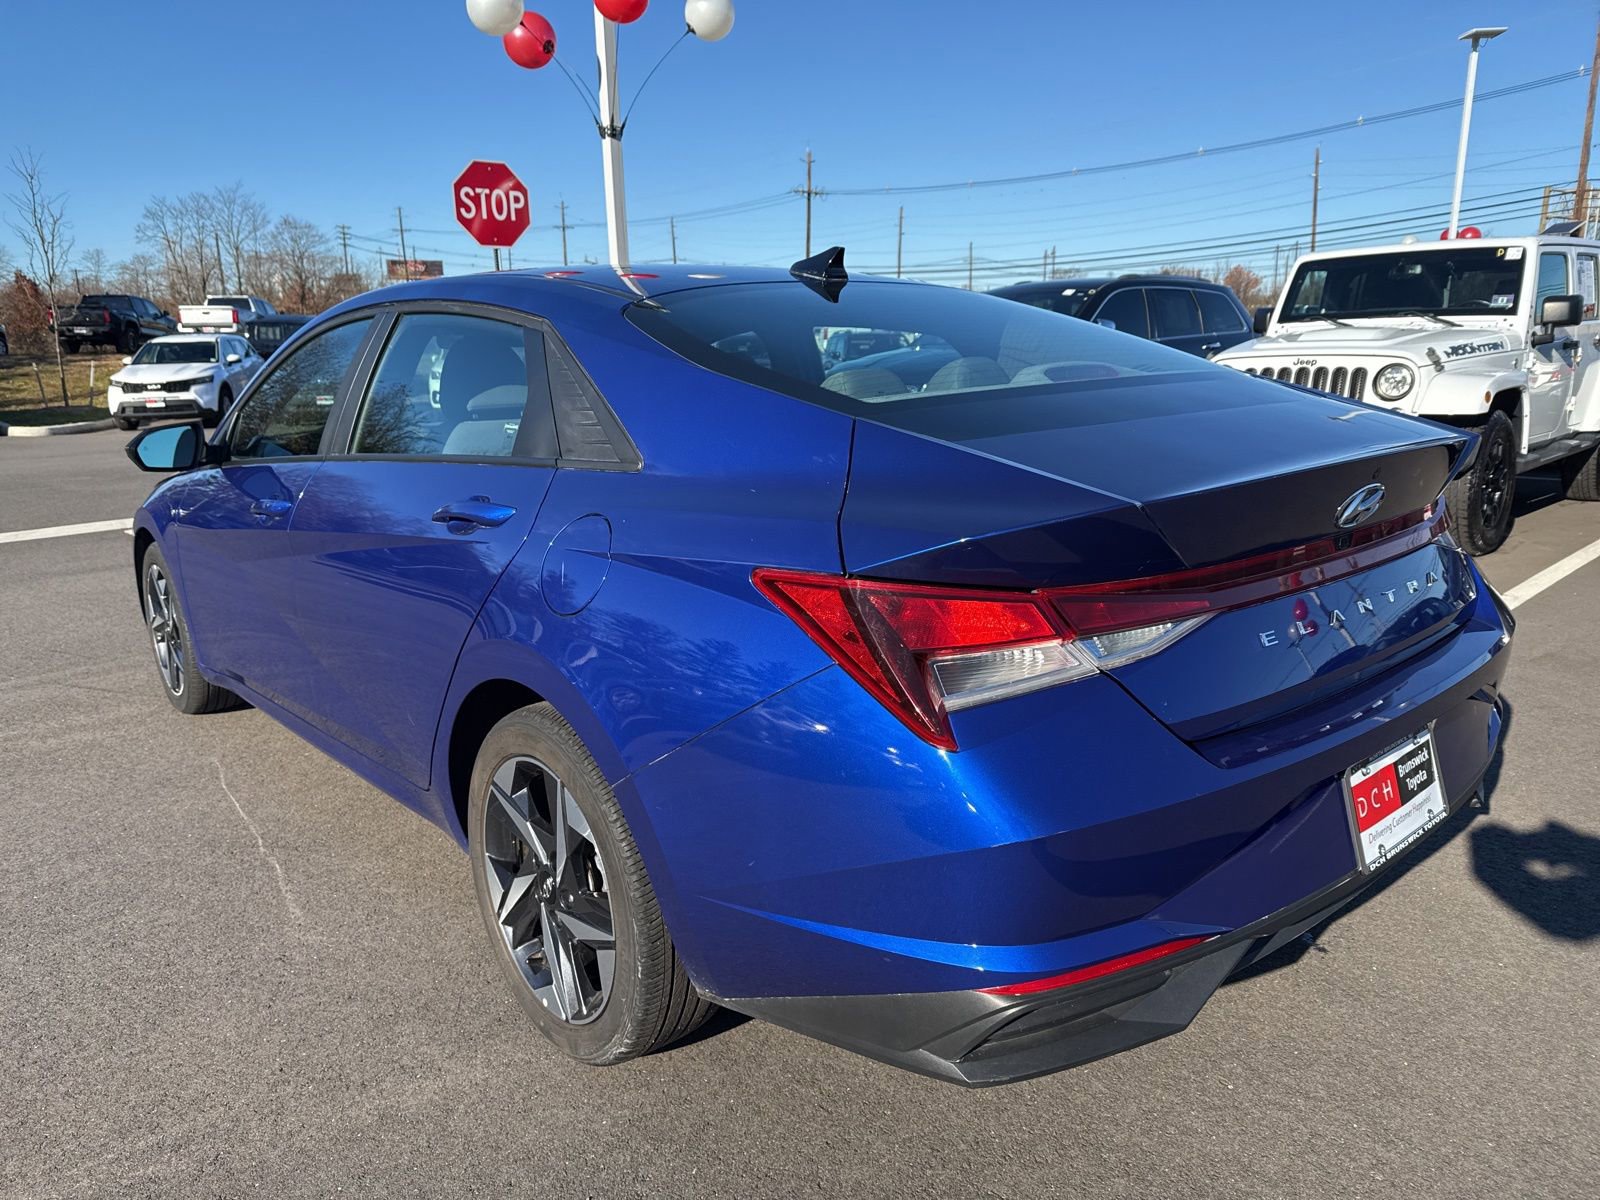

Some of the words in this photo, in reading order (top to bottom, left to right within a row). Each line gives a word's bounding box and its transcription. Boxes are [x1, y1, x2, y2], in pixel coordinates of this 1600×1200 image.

[460, 186, 525, 222] STOP
[1293, 358, 1318, 367] Jeep
[1259, 571, 1438, 648] ELANTRA
[1398, 747, 1430, 777] Brunswick
[1406, 769, 1428, 791] Toyota
[1357, 779, 1394, 818] DCH
[1368, 823, 1393, 844] Delivering
[1369, 856, 1387, 871] DCH
[1386, 828, 1425, 860] BRUNSWICK
[1424, 811, 1448, 831] TOYOTA
